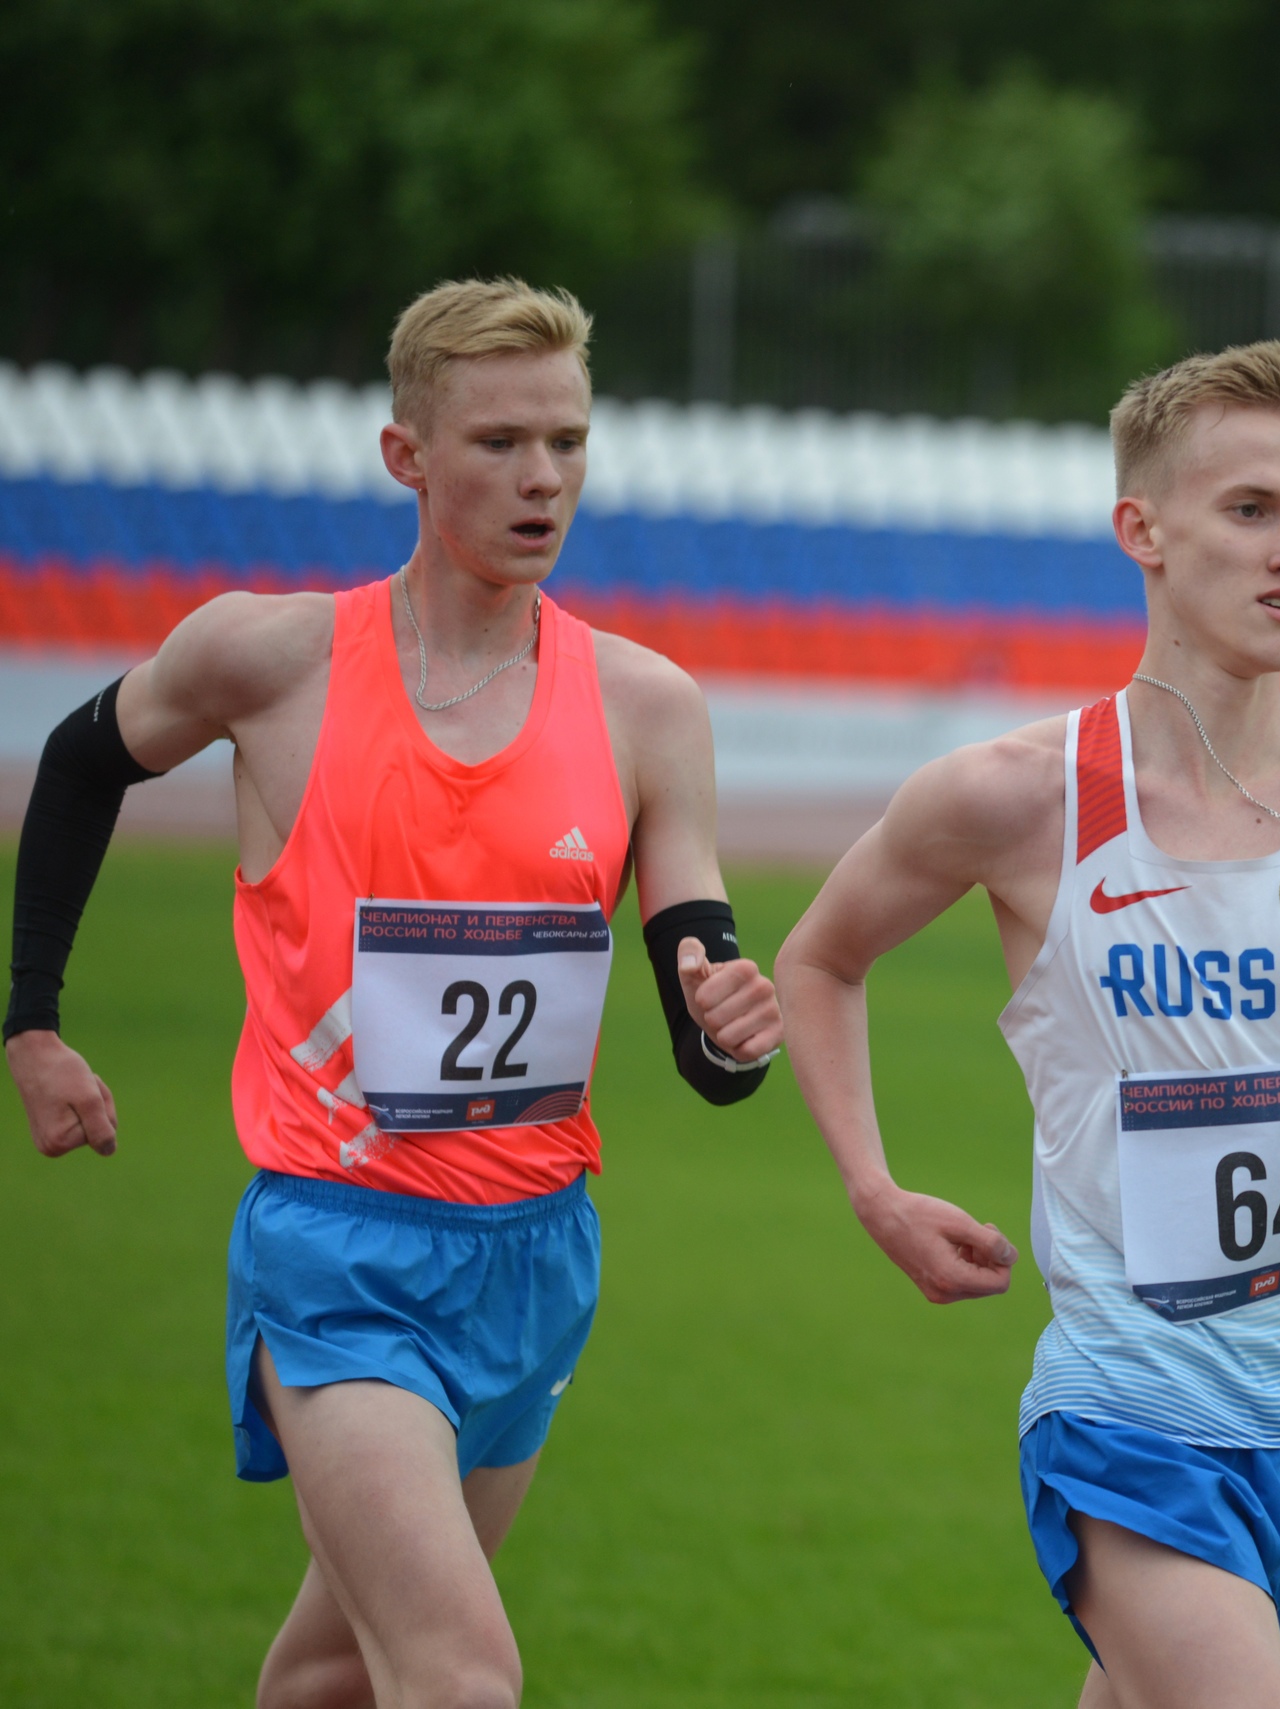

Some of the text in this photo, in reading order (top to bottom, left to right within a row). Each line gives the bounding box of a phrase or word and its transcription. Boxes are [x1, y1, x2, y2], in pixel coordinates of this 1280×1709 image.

[549, 847, 594, 862] adidas
[361, 911, 577, 927] ЧЕМПИОНАТ И ПЕРВЕНСТВА
[361, 925, 523, 942] РОССИИ ПО ХОДЬБЕ
[533, 929, 607, 939] ЧЕБОКСАРЫ 2021
[440, 979, 537, 1081] 22
[1122, 1081, 1227, 1099] ЧЕМПИОНАТ
[1234, 1080, 1247, 1092] И
[1123, 1098, 1194, 1114] РОССИИ
[1200, 1097, 1225, 1110] ПО
